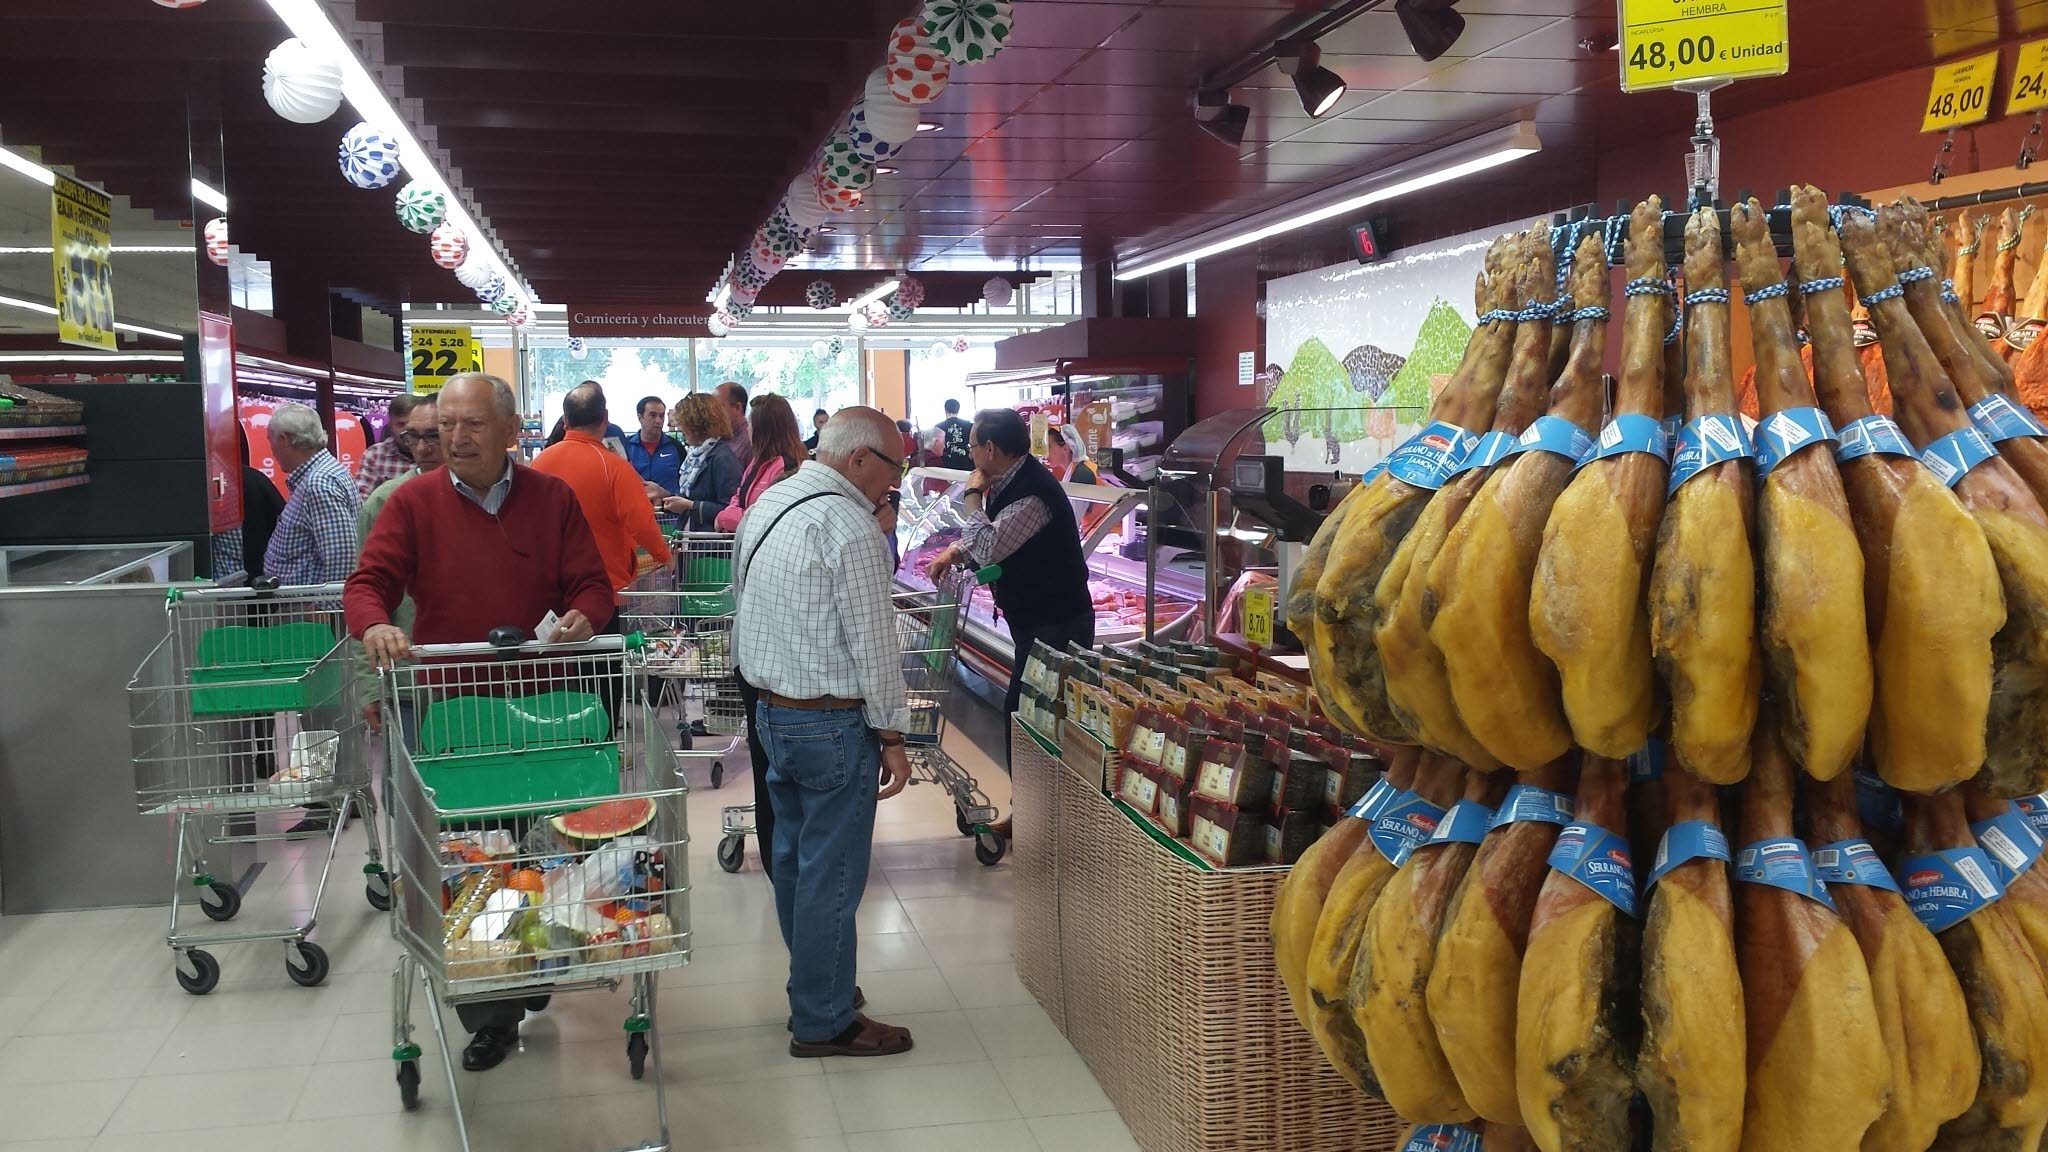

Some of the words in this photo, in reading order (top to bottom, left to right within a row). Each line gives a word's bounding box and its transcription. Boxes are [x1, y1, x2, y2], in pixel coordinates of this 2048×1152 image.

[1681, 3, 1727, 17] HEMBRA
[1631, 27, 1665, 36] INCARLOPSA
[1629, 35, 1715, 72] 48,00
[1719, 50, 1727, 60] €
[1731, 41, 1783, 59] Unidad
[1930, 86, 1984, 118] 48,00
[574, 312, 638, 325] Carnicería
[641, 316, 649, 328] y
[1088, 428, 1098, 455] carne
[1405, 471, 1417, 480] 12
[1249, 613, 1265, 635] 8,70
[1379, 819, 1420, 838] SERRANO
[1588, 861, 1624, 877] SERRANO
[1929, 886, 1969, 900] HEMBRA
